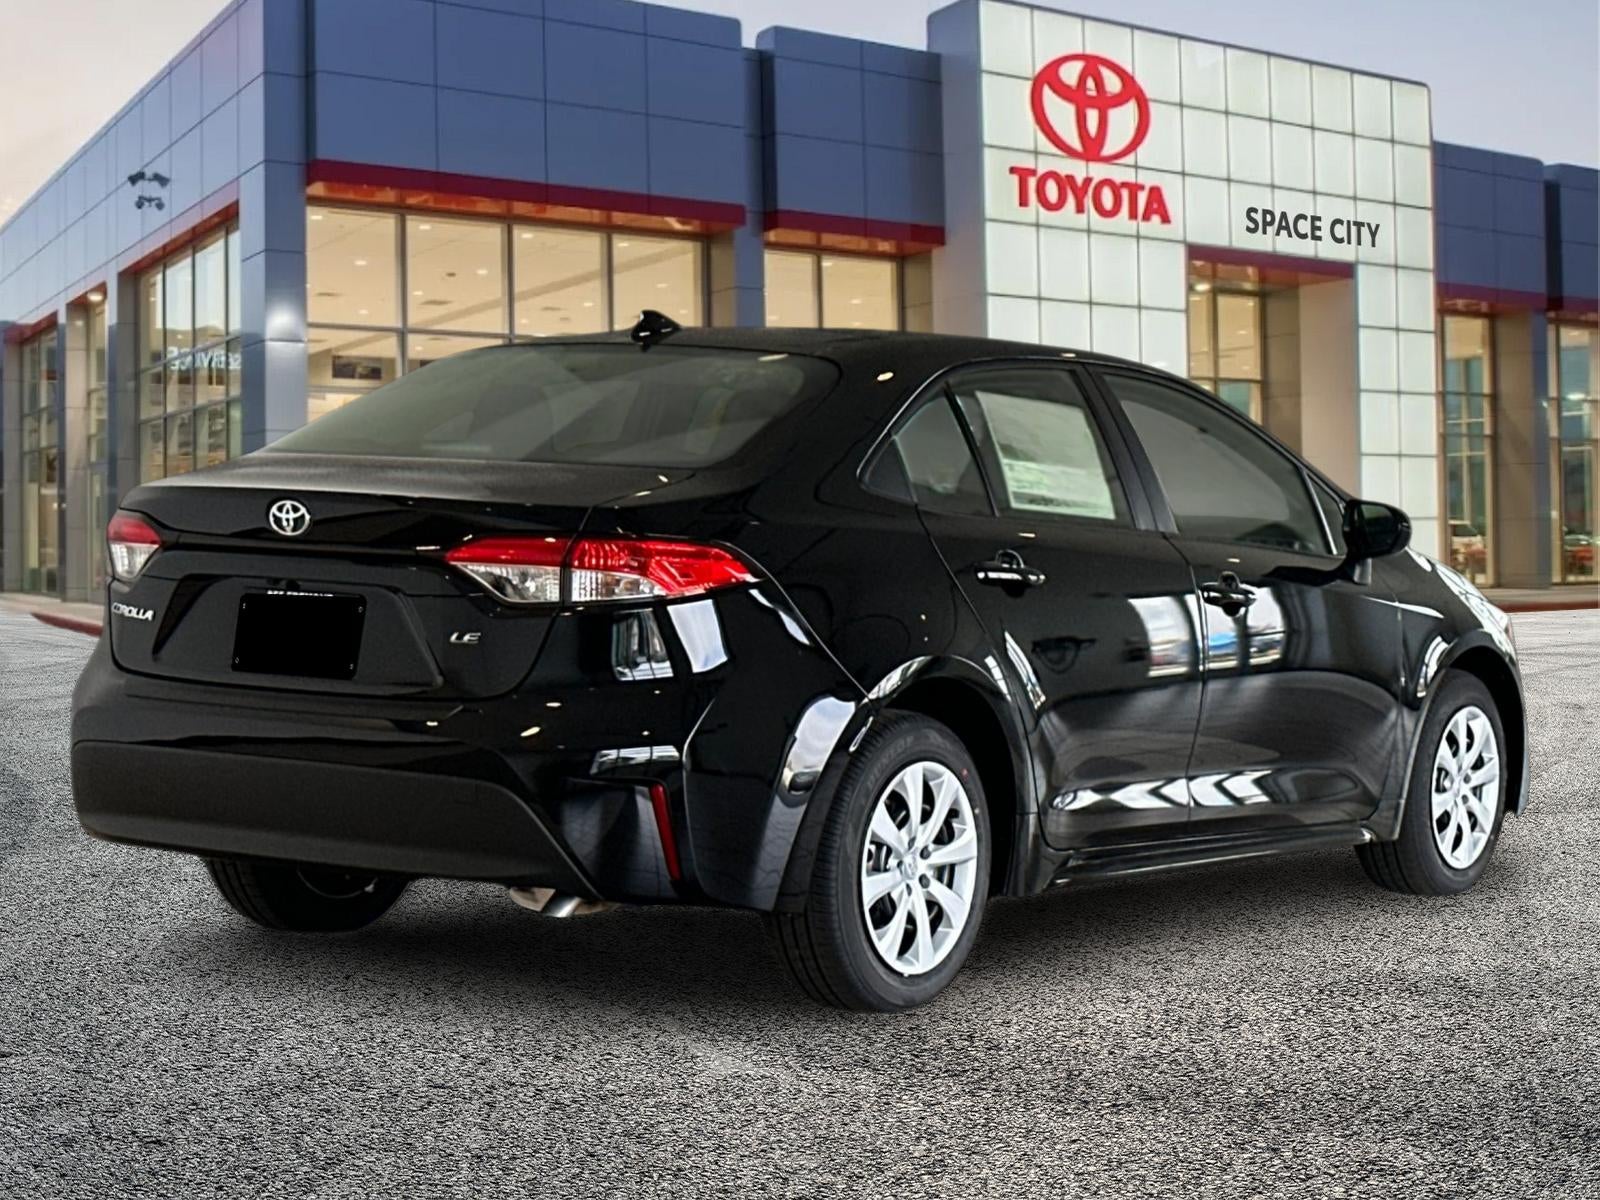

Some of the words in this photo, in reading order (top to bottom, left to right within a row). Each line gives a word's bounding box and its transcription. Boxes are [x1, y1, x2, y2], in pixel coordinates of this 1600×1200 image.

[1009, 166, 1171, 224] TOYOTA
[1246, 207, 1322, 241] SPACE
[1329, 218, 1380, 247] CITY
[111, 602, 154, 621] COROLLA
[449, 631, 482, 645] LE
